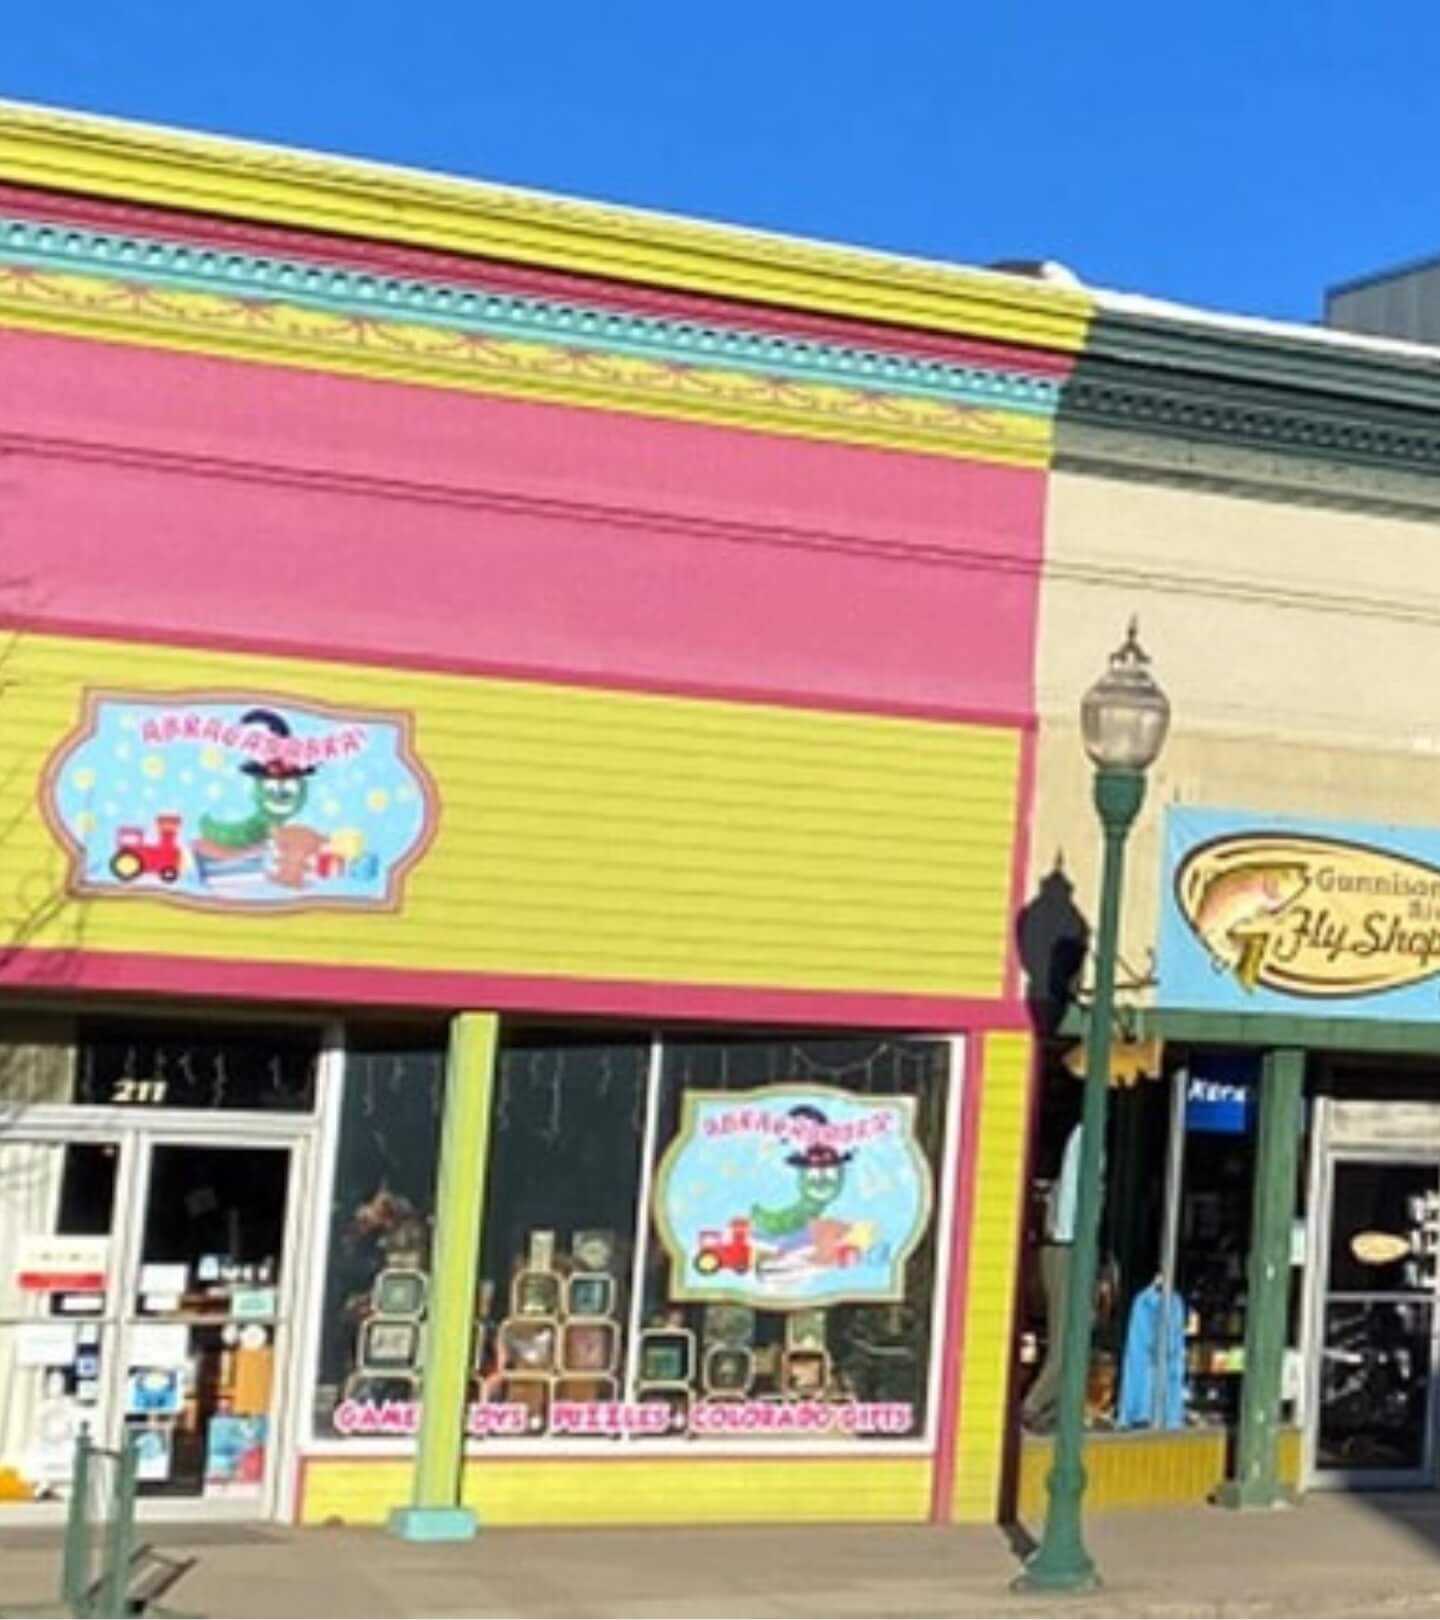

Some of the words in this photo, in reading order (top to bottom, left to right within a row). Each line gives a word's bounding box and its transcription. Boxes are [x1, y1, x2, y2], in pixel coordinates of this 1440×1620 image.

[1271, 904, 1349, 964] Fly
[111, 1077, 168, 1102] 211
[335, 1399, 421, 1432] GAME
[469, 1402, 527, 1432] OYS
[692, 1400, 831, 1432] COLORADO
